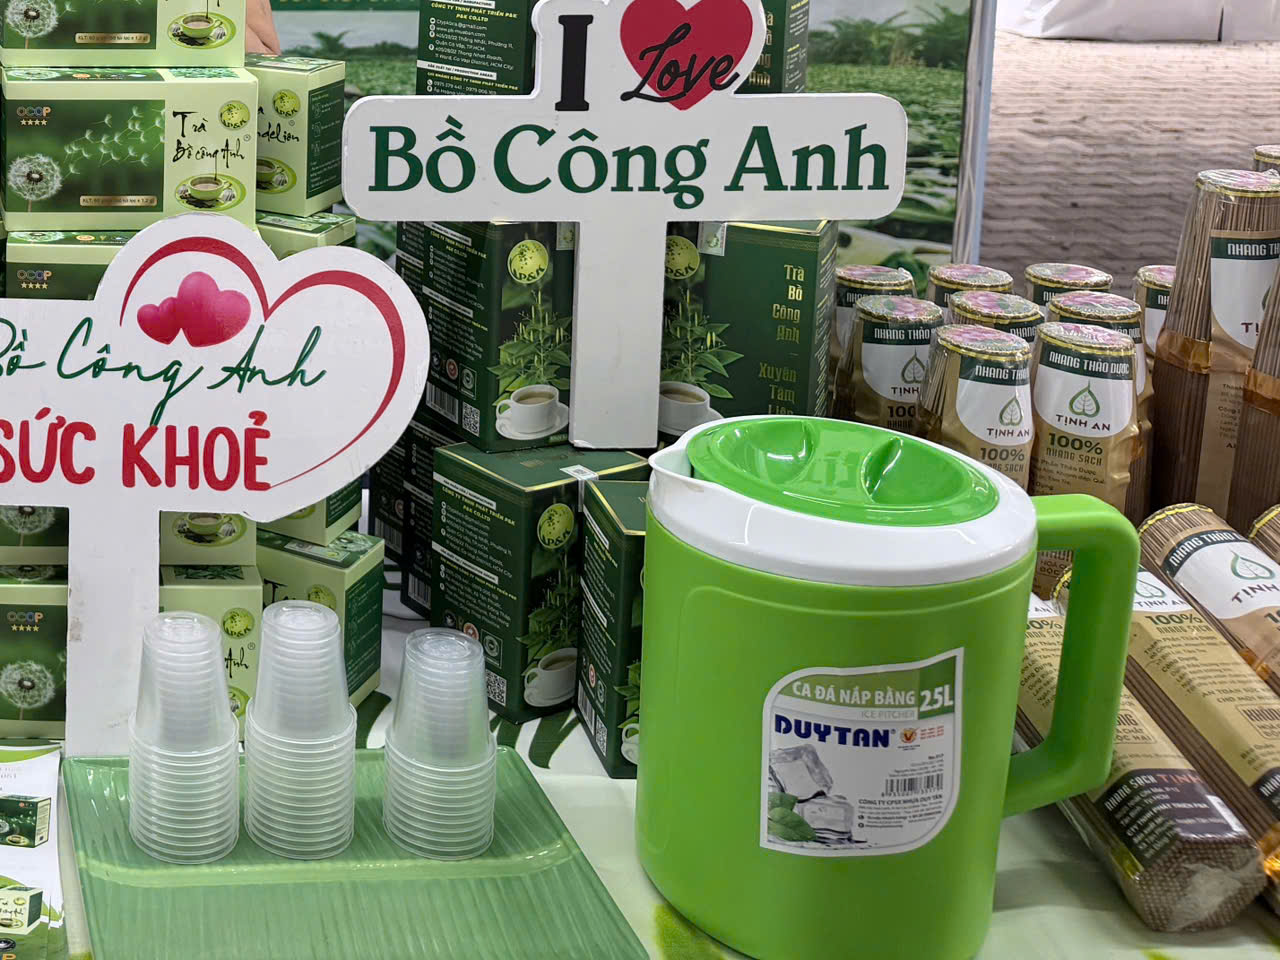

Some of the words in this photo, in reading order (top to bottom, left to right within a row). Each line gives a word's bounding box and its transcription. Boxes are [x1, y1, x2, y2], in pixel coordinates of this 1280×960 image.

[555, 14, 594, 112] I
[620, 22, 740, 103] Love
[17, 105, 51, 118] OCOP
[368, 115, 476, 192] Bồ
[493, 123, 709, 210] Công
[724, 123, 889, 192] Anh
[1228, 243, 1267, 256] NHANG
[17, 269, 52, 281] OCOP
[784, 264, 805, 282] Trà
[788, 284, 803, 301] Bồ
[772, 304, 800, 323] Công
[874, 328, 905, 339] NHANG
[908, 326, 930, 339] THẢO
[1049, 351, 1080, 368] NHANG
[1083, 358, 1109, 372] THẢO
[56, 317, 204, 427] Công
[206, 325, 327, 393] Anh
[975, 366, 1008, 380] NHANG
[891, 387, 919, 396] TỊNH
[1056, 414, 1088, 428] TỊNH
[1091, 422, 1111, 431] AN
[987, 428, 1014, 439] TỊNH
[1017, 429, 1029, 437] AN
[122, 411, 272, 492] KHOẺ
[1048, 433, 1103, 455] 100%
[980, 448, 1024, 461] 100%
[1046, 448, 1075, 460] NHANG
[1078, 454, 1103, 467] SẠCH
[1169, 534, 1204, 569] NHANG
[1203, 530, 1236, 546] THẢO
[1145, 612, 1204, 626] 100%
[792, 681, 811, 698] CA
[815, 685, 835, 702] ĐÁ
[840, 685, 871, 705] NẮP
[874, 686, 915, 705] BẰNG
[774, 714, 890, 748] DUYTAN
